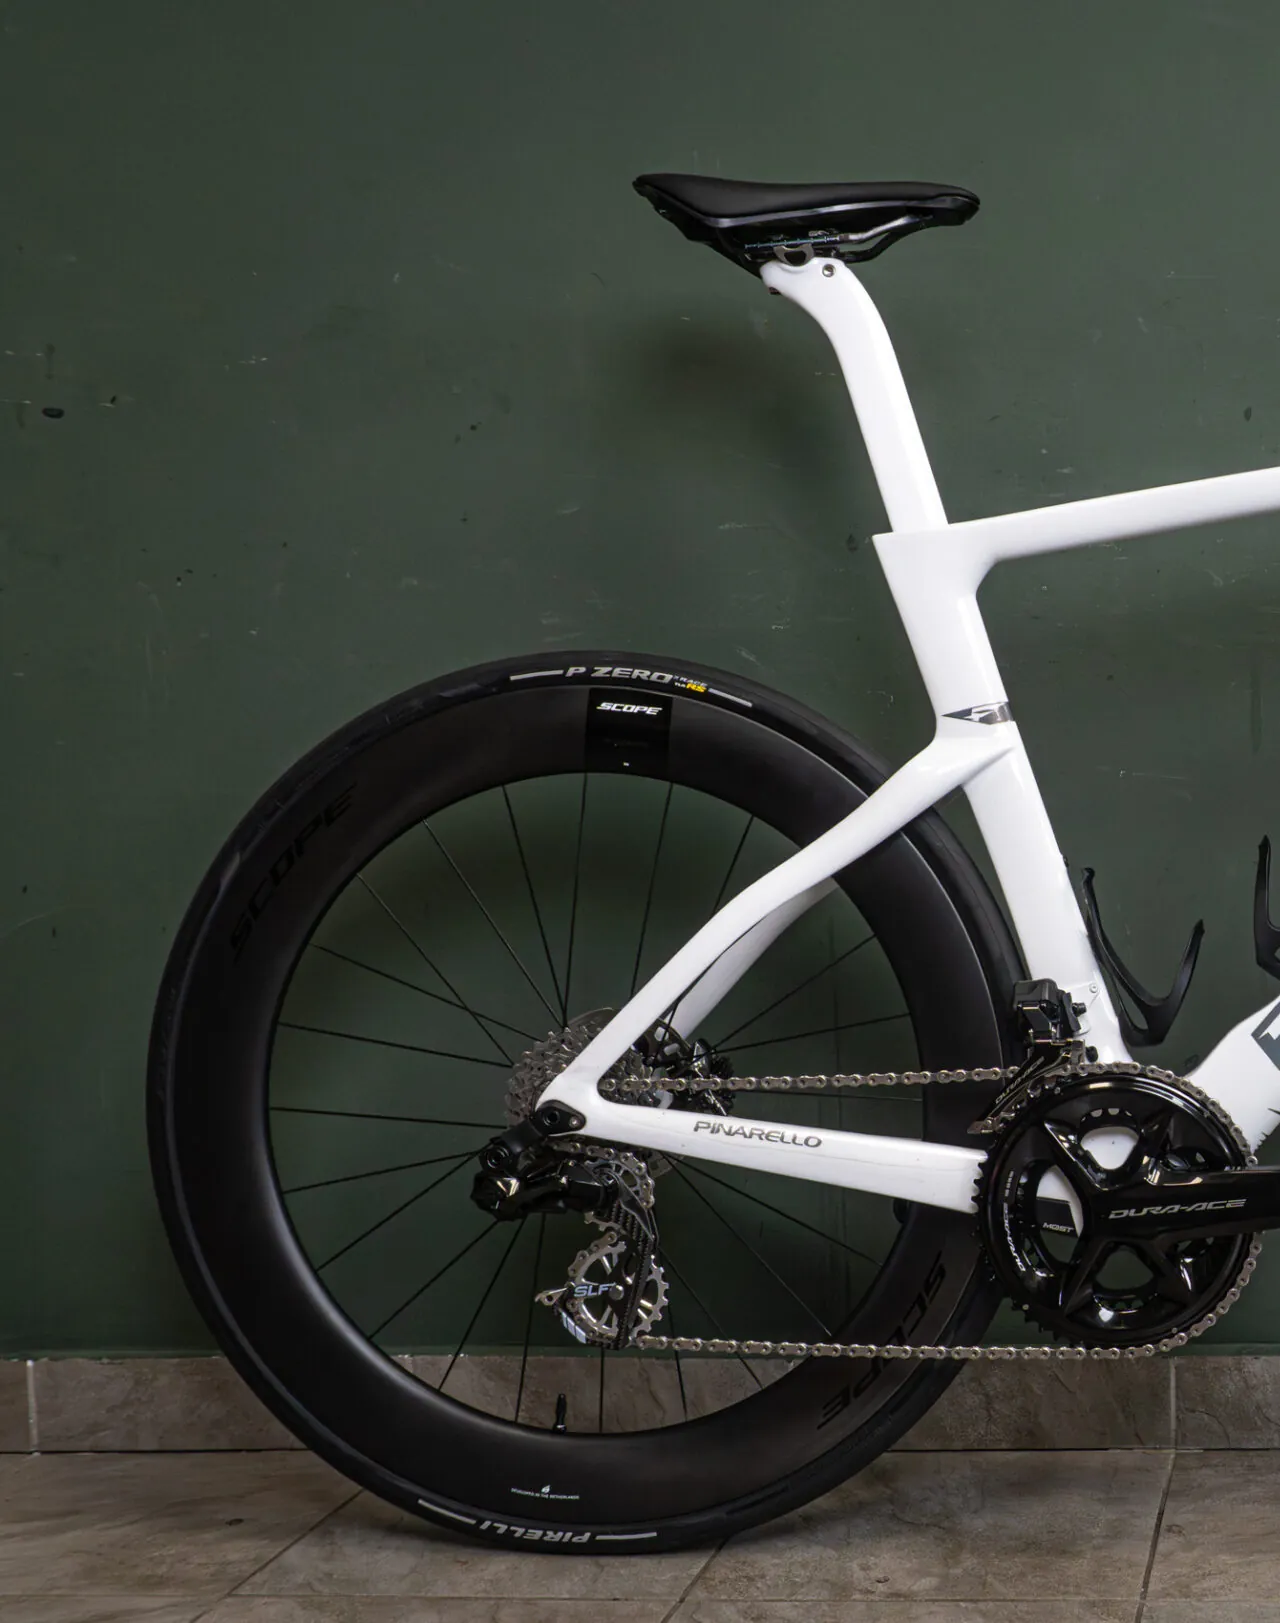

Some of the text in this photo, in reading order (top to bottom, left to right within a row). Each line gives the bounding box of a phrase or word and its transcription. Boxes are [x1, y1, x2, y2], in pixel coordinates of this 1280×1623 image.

[564, 666, 674, 684] P ZERO
[595, 701, 664, 716] SCOPE
[230, 781, 358, 966] SCOPE
[693, 1120, 823, 1149] PINARELLO
[1108, 1198, 1248, 1220] DURA-ACE
[1041, 1221, 1075, 1234] MOST
[479, 1520, 592, 1544] PIRELLI
